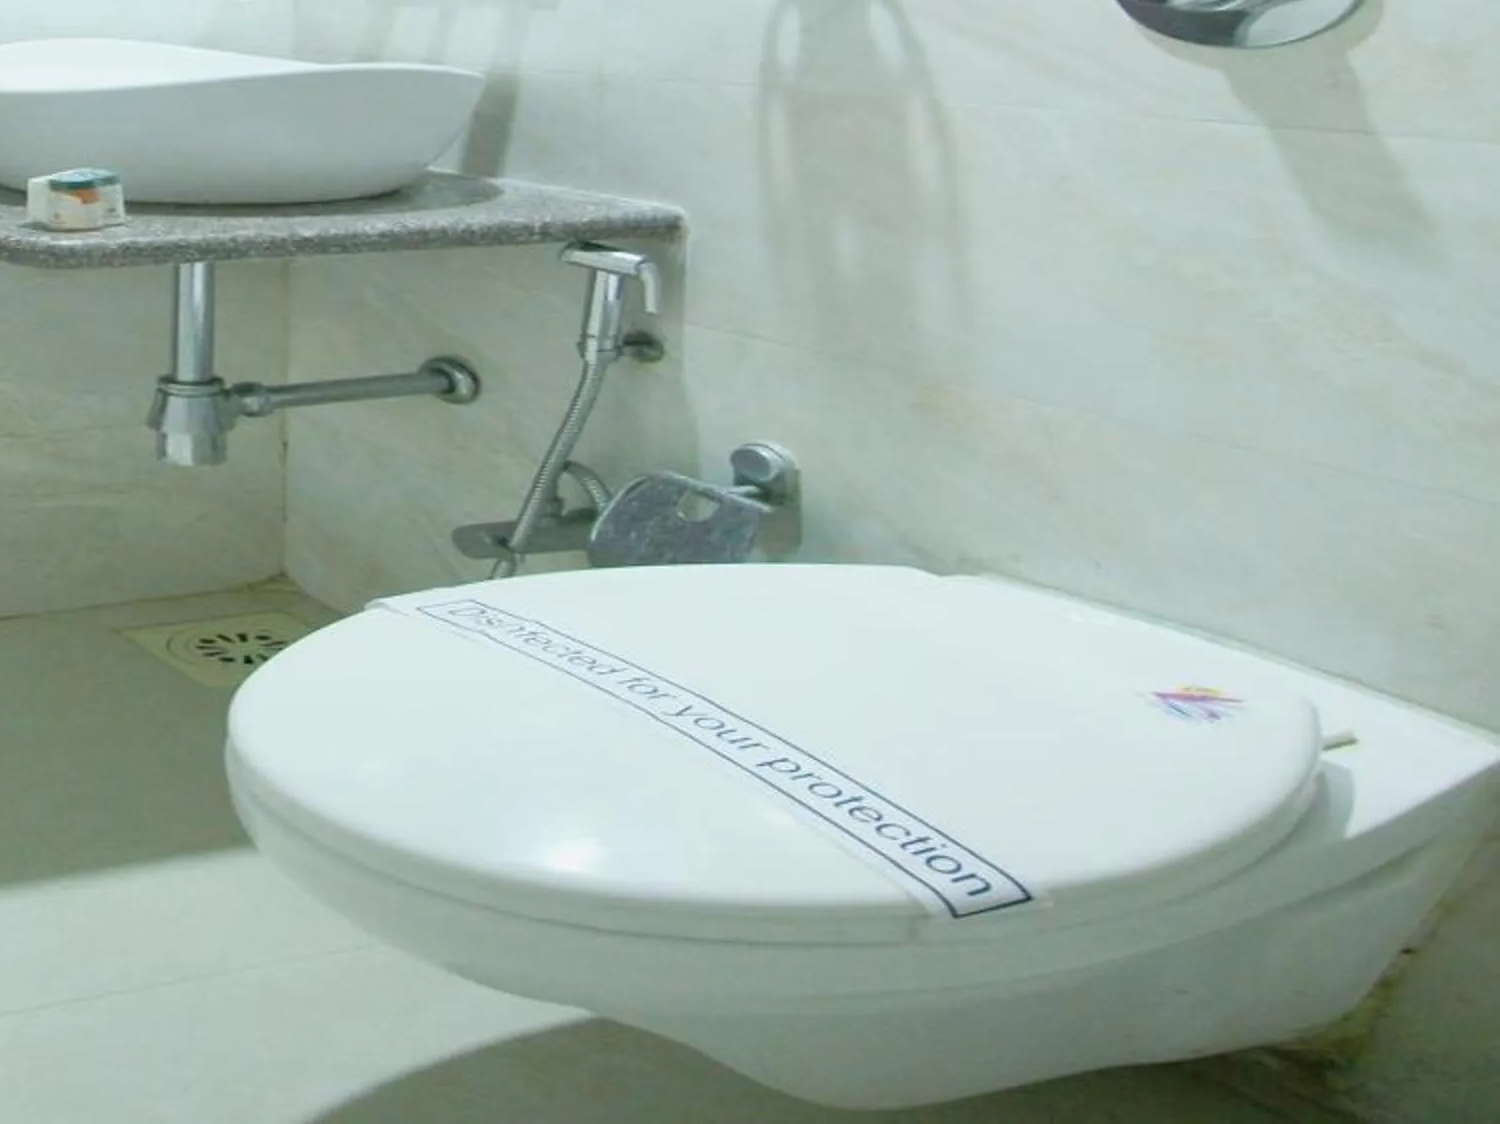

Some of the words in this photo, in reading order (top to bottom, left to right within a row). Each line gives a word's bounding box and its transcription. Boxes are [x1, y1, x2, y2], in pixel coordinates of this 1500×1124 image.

[616, 677, 676, 700] for
[661, 704, 770, 749] your
[756, 757, 992, 896] protection
